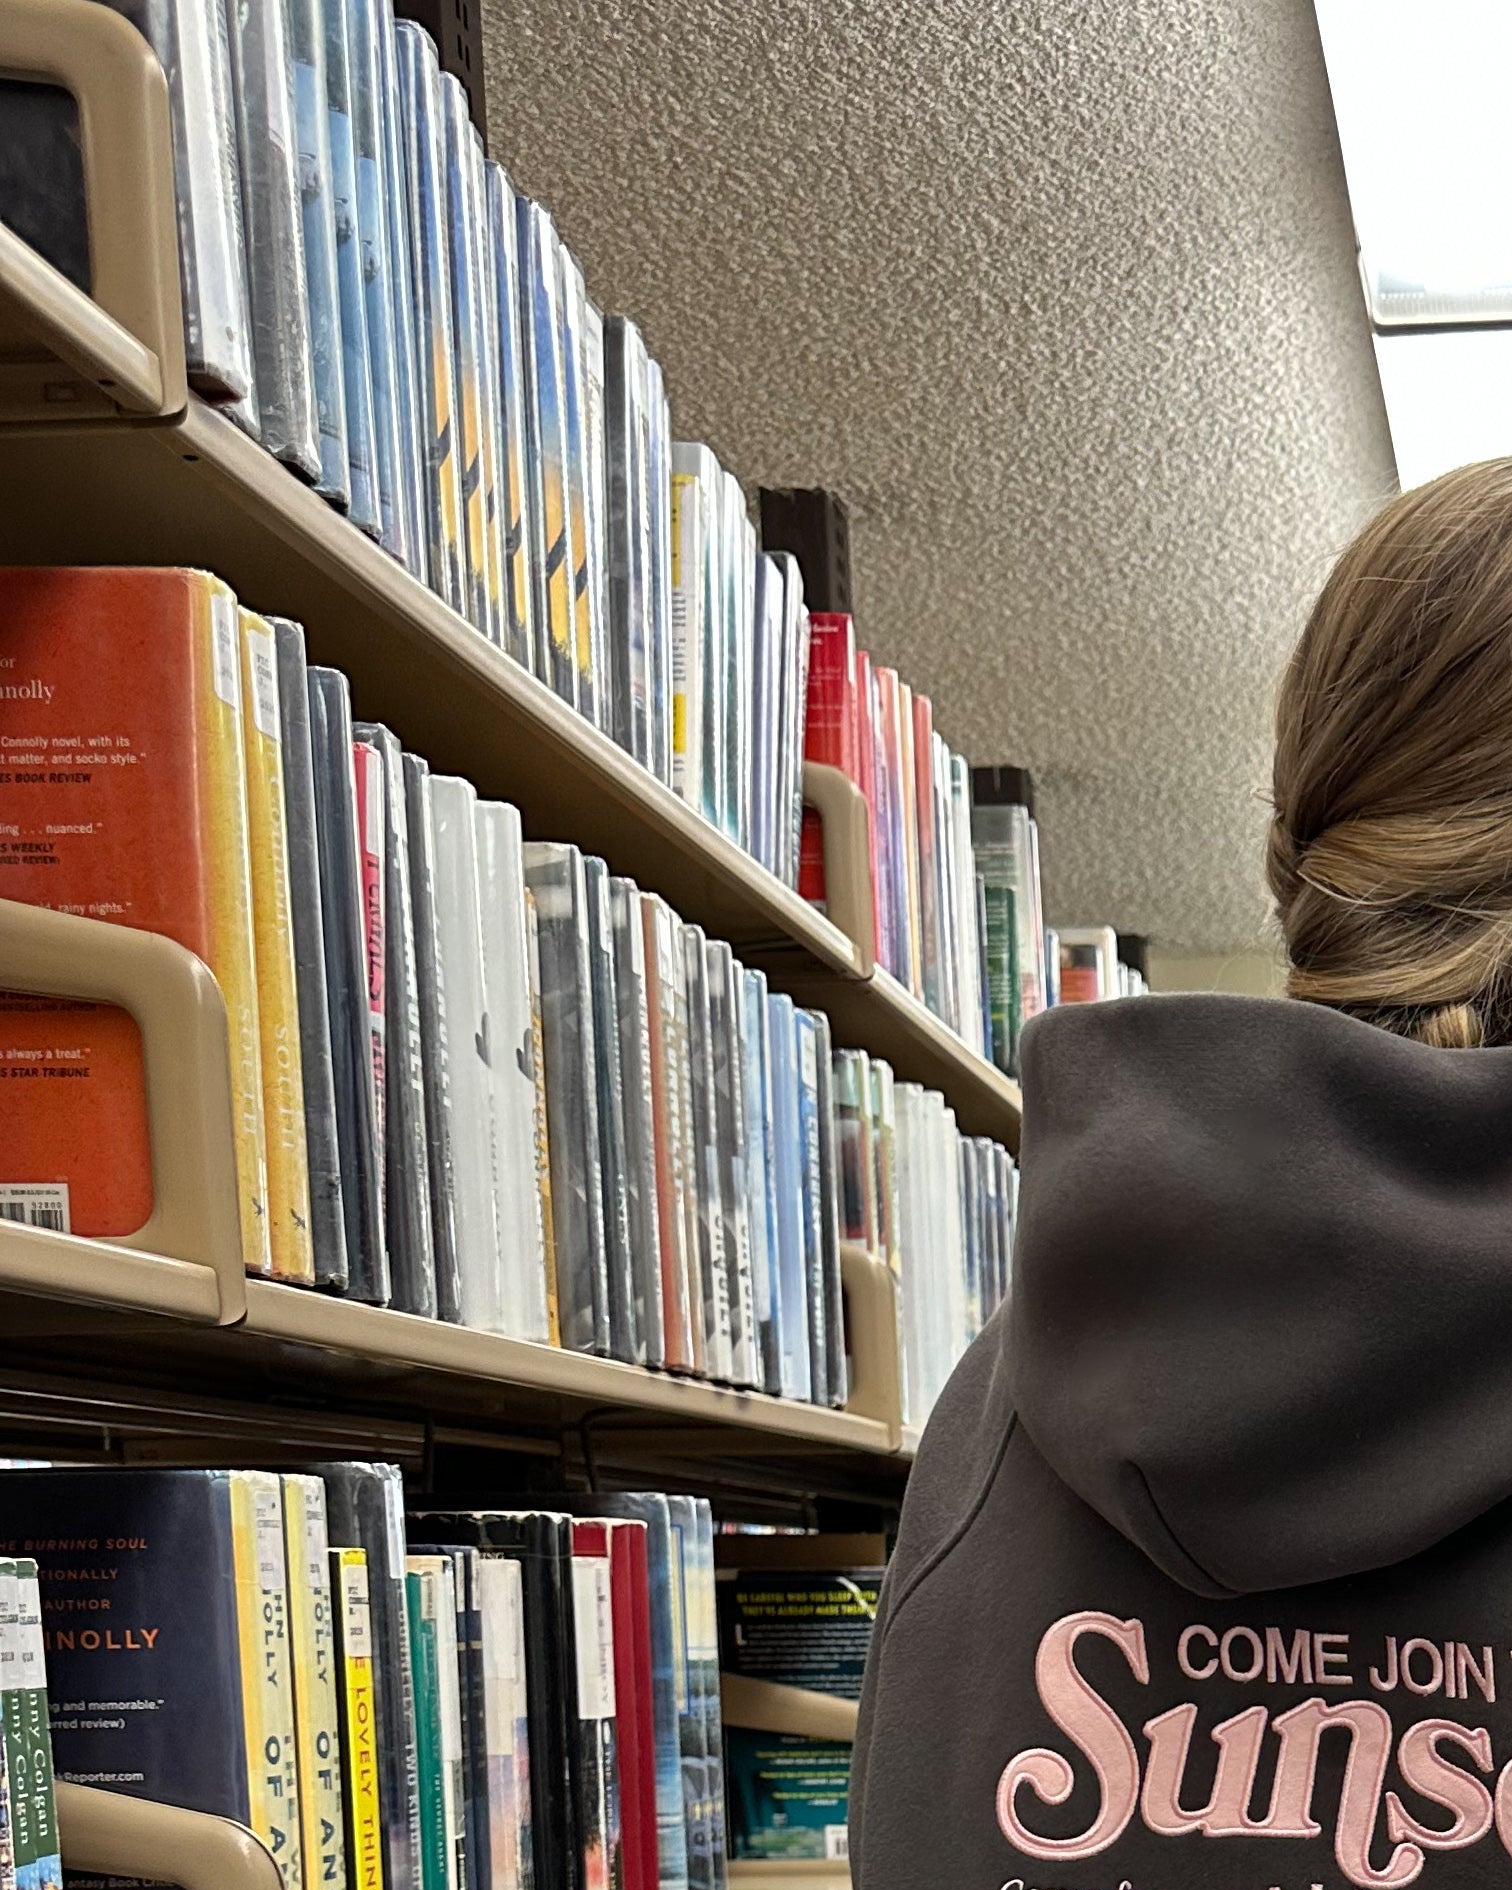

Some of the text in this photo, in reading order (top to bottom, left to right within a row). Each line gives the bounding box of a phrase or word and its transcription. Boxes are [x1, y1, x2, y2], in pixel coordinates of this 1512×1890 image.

[1, 736, 130, 749] Connolly novel, with its
[9, 753, 72, 765] matter, and
[15, 772, 91, 784] BOOK REVIEW
[11, 1067, 90, 1079] STAR TRIBUNE
[24, 1538, 149, 1552] BURNING SOUL
[44, 1599, 112, 1611] AUTHOR
[1177, 1625, 1354, 1686] COME
[1370, 1636, 1497, 1704] JOIN
[63, 1701, 86, 1712] and
[355, 1686, 372, 1798] LOVELY
[264, 1735, 284, 1798] OF
[315, 1730, 334, 1792] OF
[15, 1754, 29, 1846] Colgan
[33, 1748, 49, 1838] Colgan
